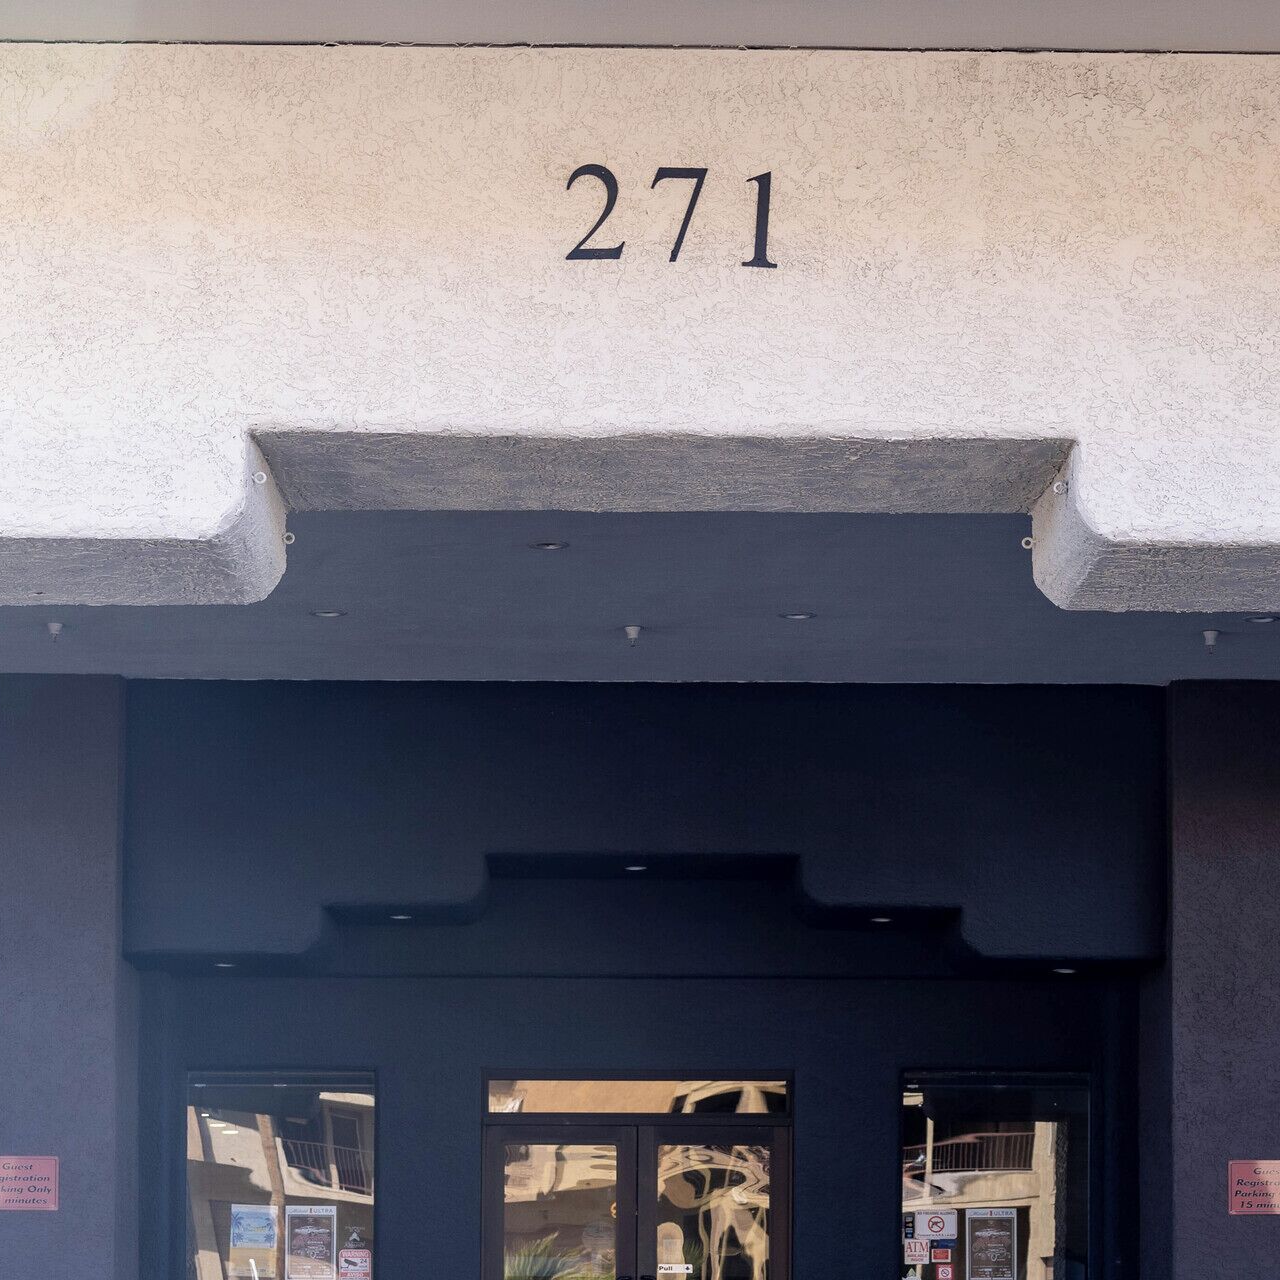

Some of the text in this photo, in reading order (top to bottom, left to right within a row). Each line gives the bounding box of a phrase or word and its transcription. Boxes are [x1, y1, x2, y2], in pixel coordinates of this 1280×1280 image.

[565, 163, 777, 268] 271
[2, 1162, 33, 1170] Guest
[27, 1185, 52, 1194] Only
[1234, 1190, 1275, 1199] Parking
[4, 1196, 48, 1204] minutes
[1240, 1201, 1253, 1209] 15
[905, 1241, 929, 1253] ATM
